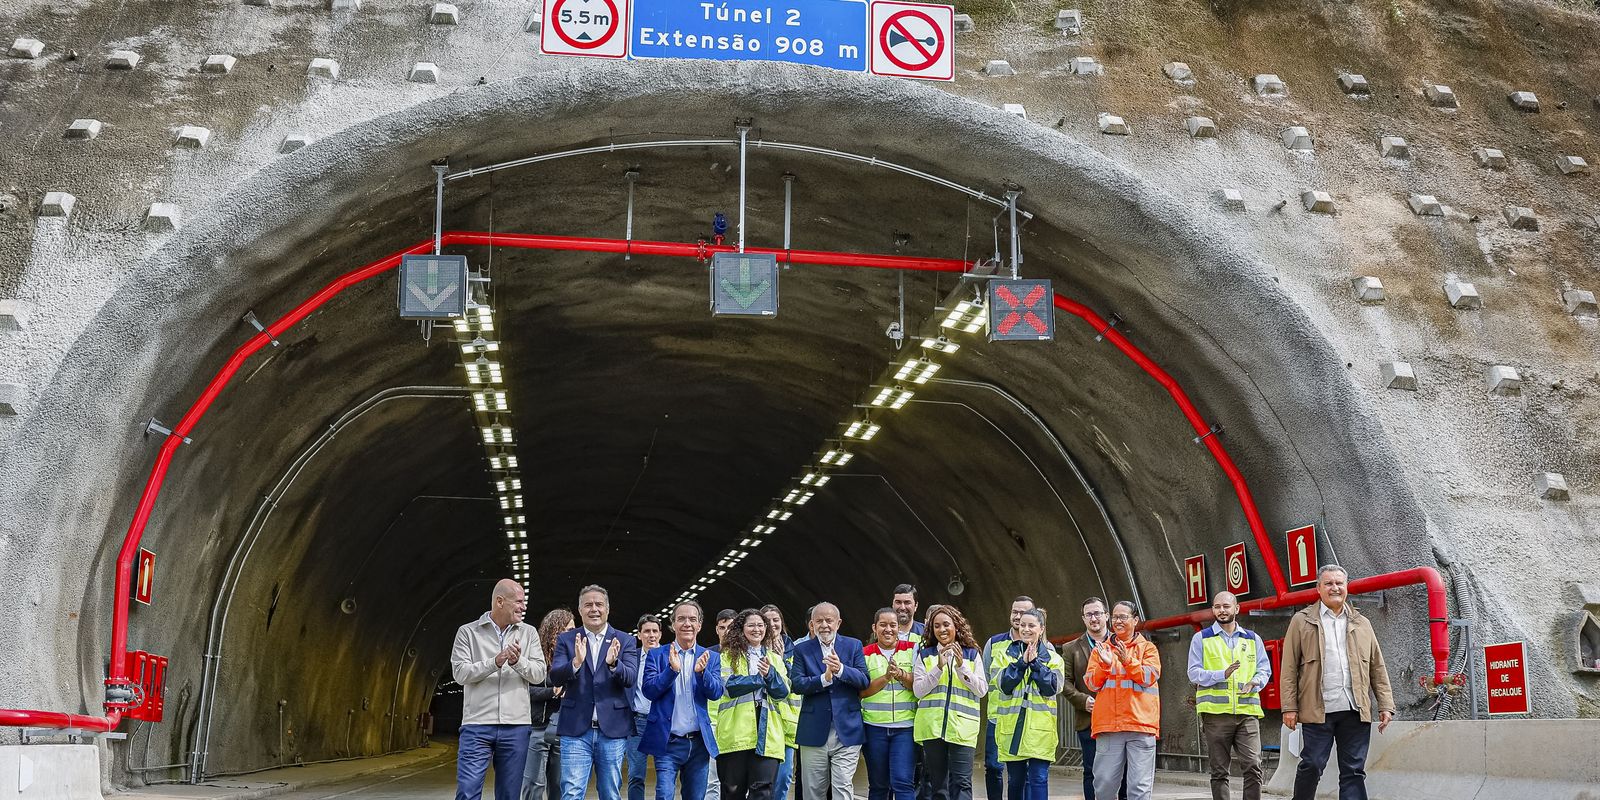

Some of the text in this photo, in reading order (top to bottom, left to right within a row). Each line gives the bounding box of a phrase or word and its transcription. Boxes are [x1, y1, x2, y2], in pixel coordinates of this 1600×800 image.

[700, 2, 801, 27] Túnel 2
[640, 27, 858, 59] Extensão 908 m
[1188, 561, 1203, 599] H
[1489, 659, 1519, 670] HIDRANTE
[1500, 674, 1510, 683] DE
[1490, 687, 1523, 697] RECALQUE
